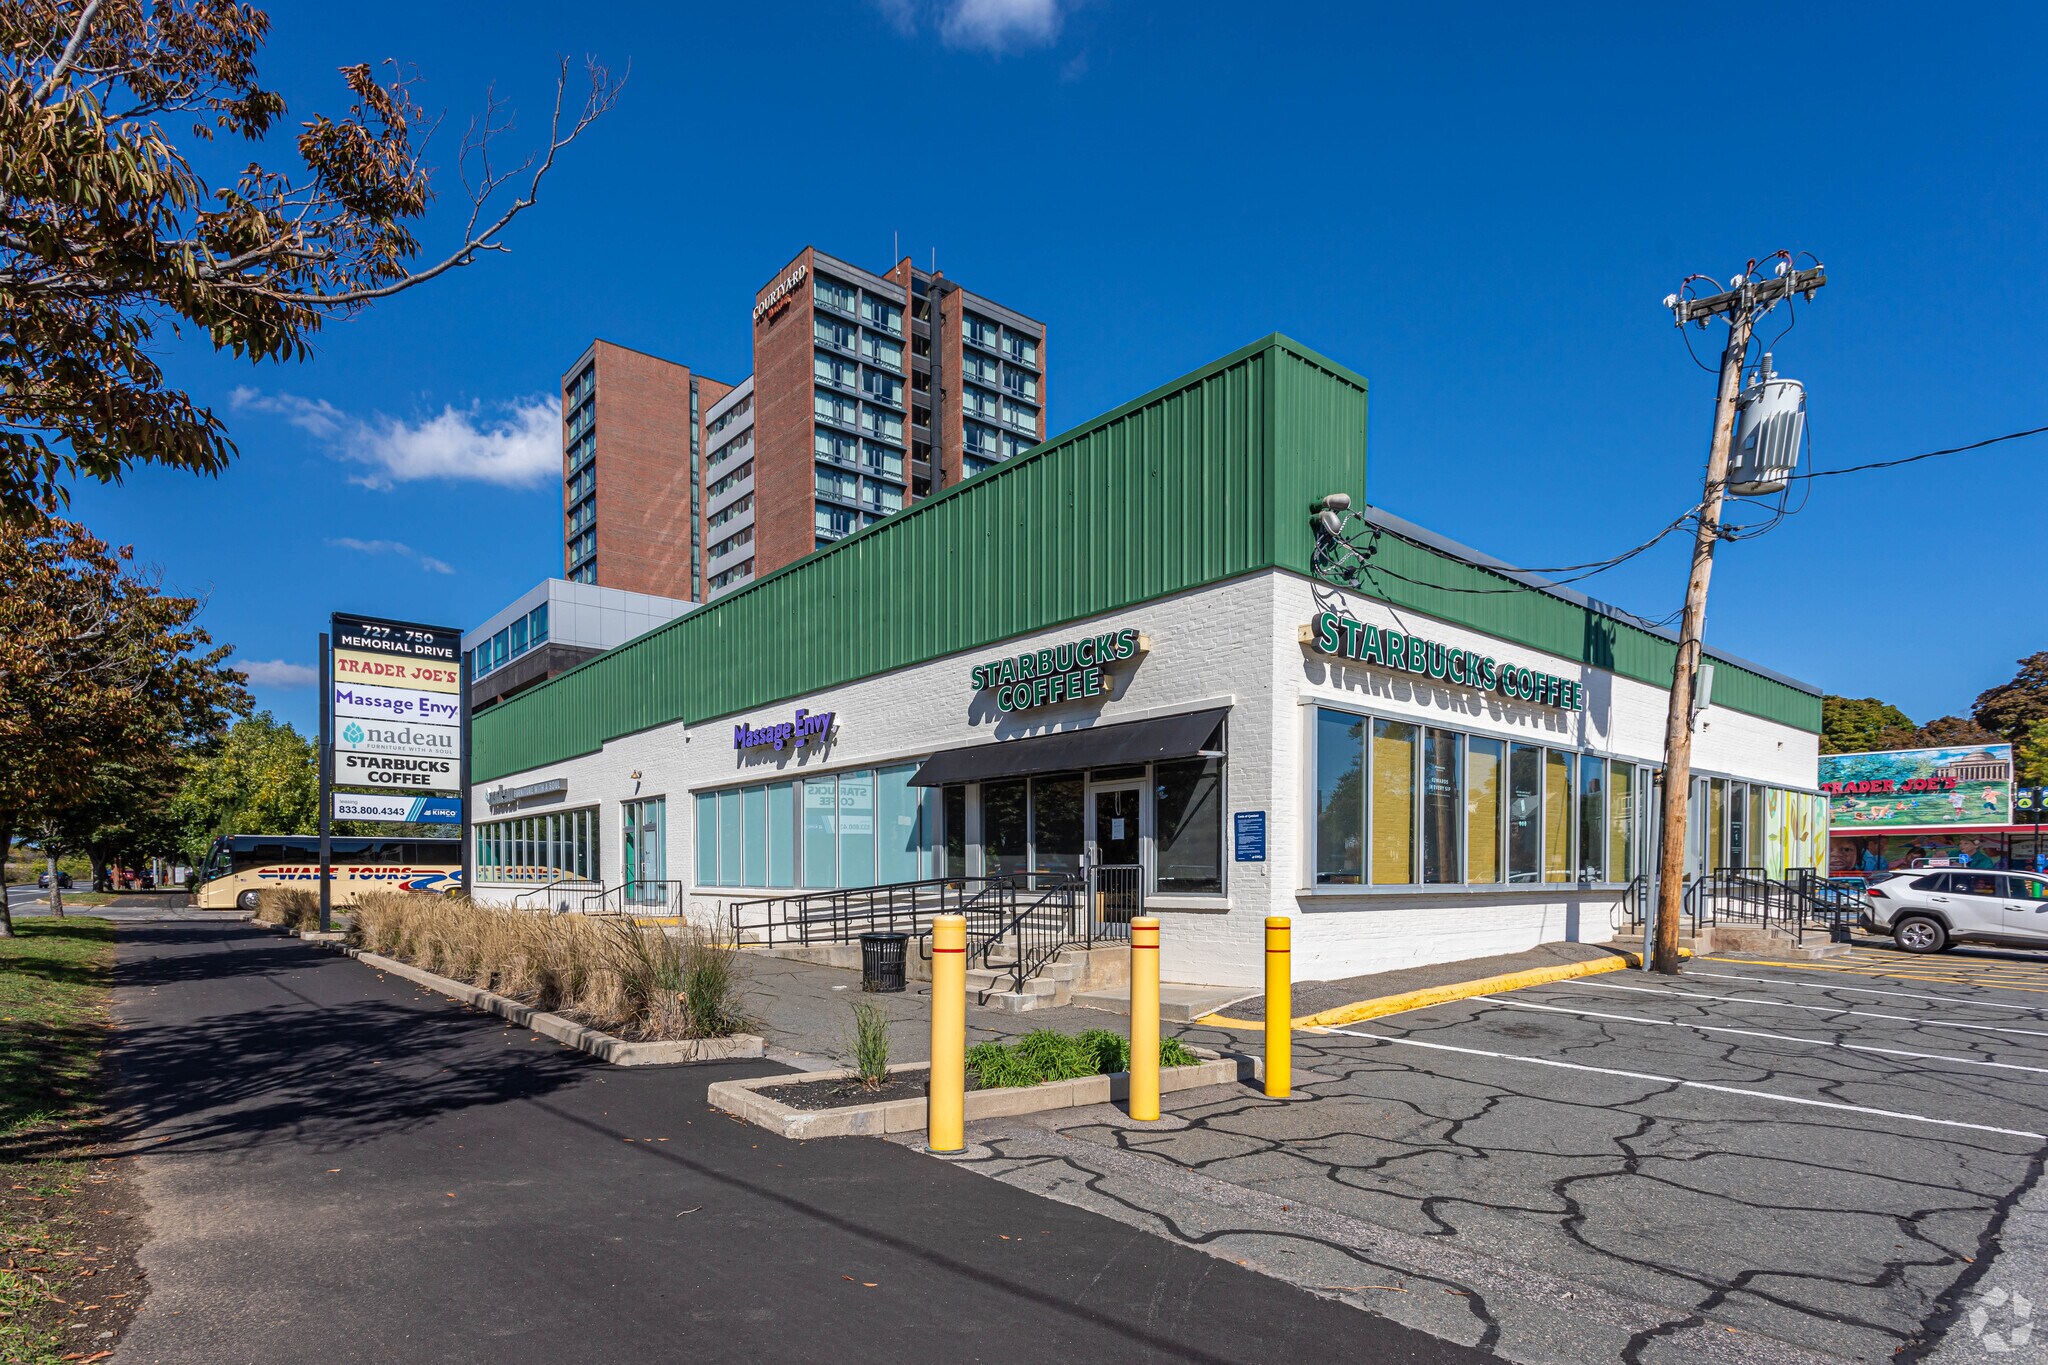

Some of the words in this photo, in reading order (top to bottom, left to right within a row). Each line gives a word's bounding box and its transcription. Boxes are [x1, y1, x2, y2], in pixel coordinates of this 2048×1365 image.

[753, 264, 806, 320] COURTYARD
[362, 625, 391, 638] 727
[405, 631, 434, 644] 750
[341, 635, 412, 653] MEMORIAL
[415, 646, 453, 658] DRIVE
[338, 659, 407, 678] TRADER
[410, 667, 457, 683] JOE'S
[970, 628, 1136, 691] STARBUCKS
[1318, 611, 1497, 691] STARBUCKS
[1502, 662, 1583, 711] COFFEE
[996, 667, 1100, 712] COFFEE
[336, 689, 414, 714] Massage
[419, 697, 458, 719] Envy
[367, 727, 453, 748] nadeau
[734, 723, 795, 751] Massage
[795, 709, 835, 748] Envy
[346, 755, 450, 773] STARBUCKS
[367, 771, 431, 785] COFFEE
[1820, 779, 1895, 794] TRADER
[1901, 776, 1958, 792] JOE'S
[338, 805, 405, 816] 833.800.4343
[348, 867, 412, 880] TOURS
